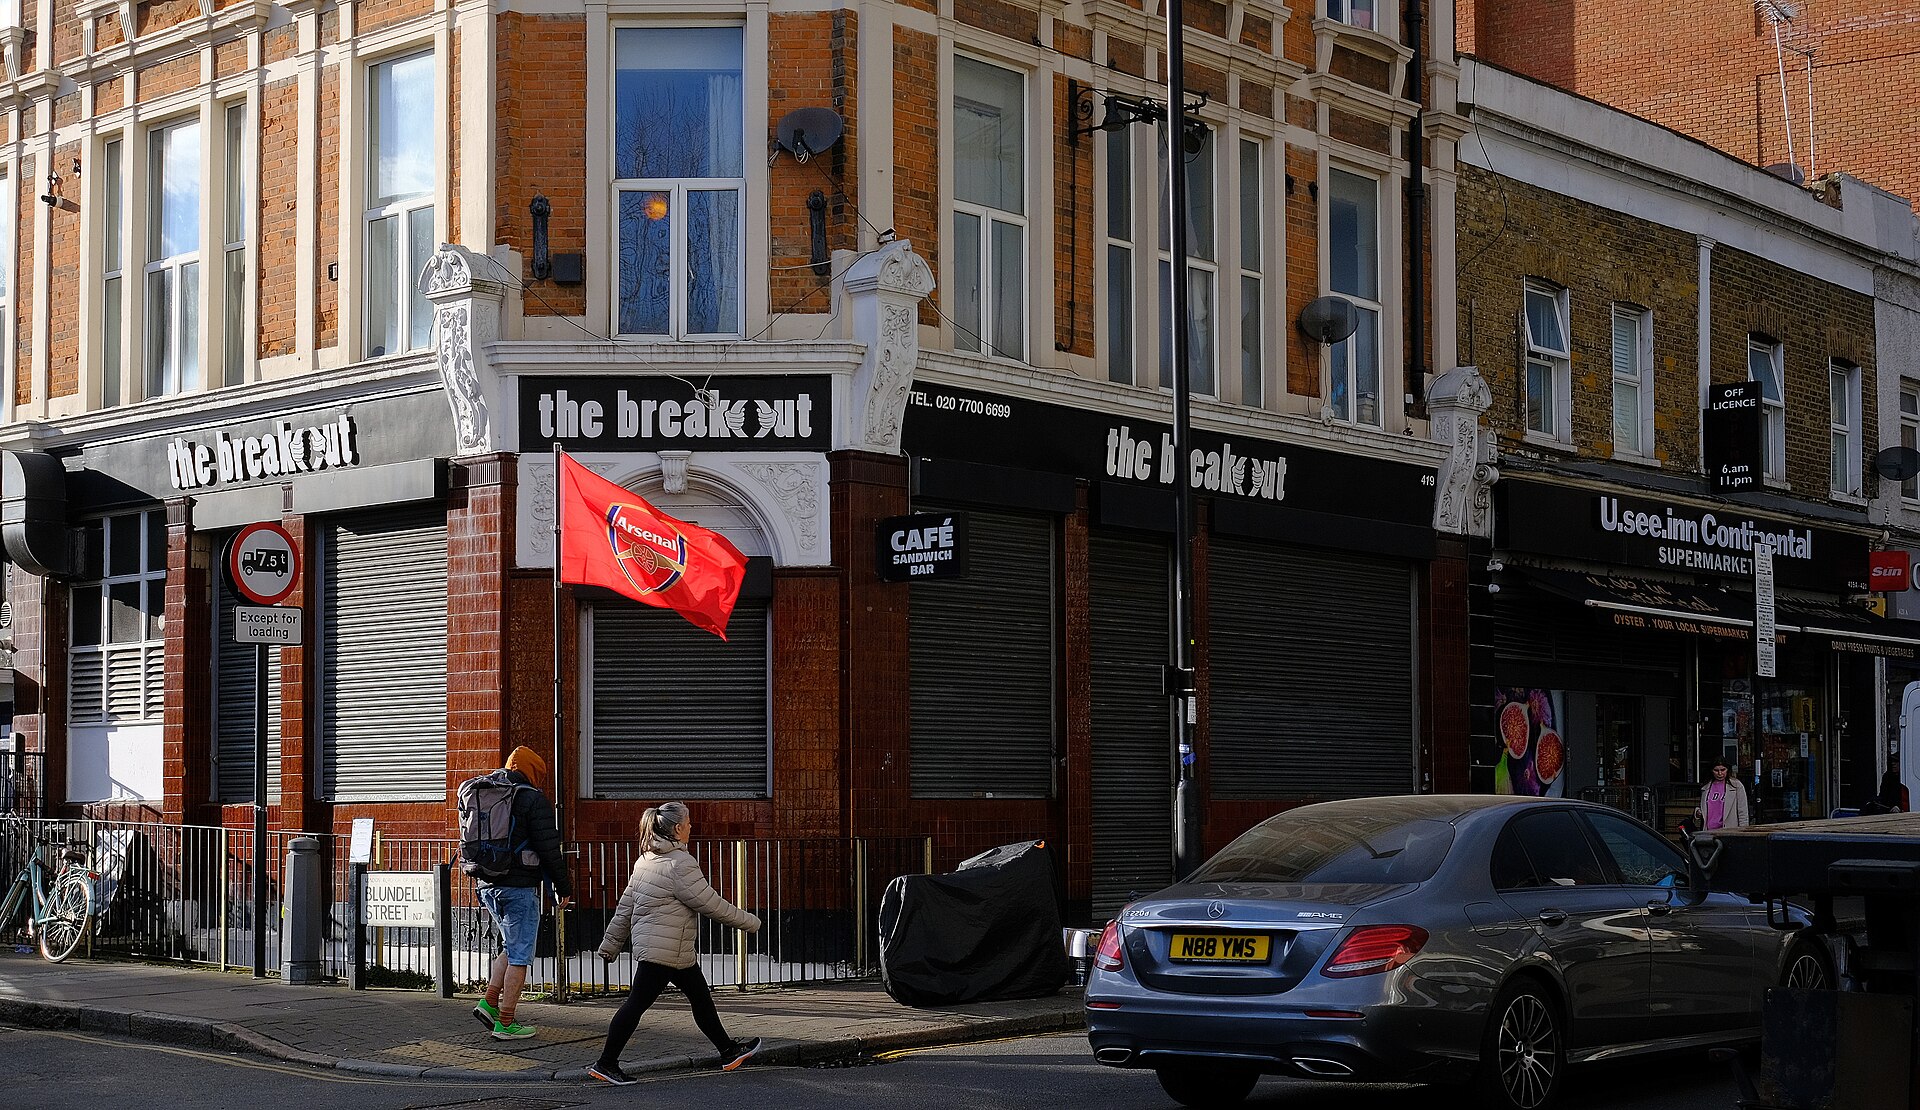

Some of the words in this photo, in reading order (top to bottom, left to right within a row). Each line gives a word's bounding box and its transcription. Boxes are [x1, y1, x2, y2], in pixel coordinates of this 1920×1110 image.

[1724, 388, 1744, 398] OFF
[936, 395, 956, 410] 020
[958, 398, 983, 414] 7700
[985, 402, 1011, 418] 6699
[1713, 398, 1756, 411] LICENCE
[539, 390, 603, 438] the
[167, 437, 211, 488] the
[1106, 426, 1152, 481] the
[1160, 432, 1287, 501] beakout
[1722, 463, 1749, 474] 6.am
[1421, 475, 1435, 487] 419
[1720, 475, 1753, 488] 11.pm
[1600, 496, 1698, 543] U.see.inn
[615, 516, 677, 552] Arsenal
[890, 517, 954, 552] CAFÉ
[257, 551, 277, 567] 7.5
[281, 553, 286, 564] t
[892, 550, 953, 565] SANDWICH
[1658, 546, 1753, 575] SUPERMARKET
[910, 564, 935, 576] BAR
[1871, 567, 1903, 577] Sun
[240, 612, 278, 625] Except
[282, 613, 297, 624] for
[1613, 613, 1645, 628] OYSTER
[1652, 618, 1674, 631] YOUR
[1675, 621, 1699, 634] LOCAL
[1700, 625, 1749, 640] SUPERMARKET
[249, 626, 289, 640] loading
[1831, 640, 1847, 651] DAILY
[1847, 642, 1864, 653] FRESH
[1864, 643, 1880, 654] FRUITS
[1885, 645, 1914, 658] VEGETABLES
[365, 886, 424, 902] BLUNDELL
[365, 904, 408, 920] STREET
[412, 912, 422, 920] N7
[1182, 937, 1217, 956] N88
[1222, 938, 1257, 957] YMS
